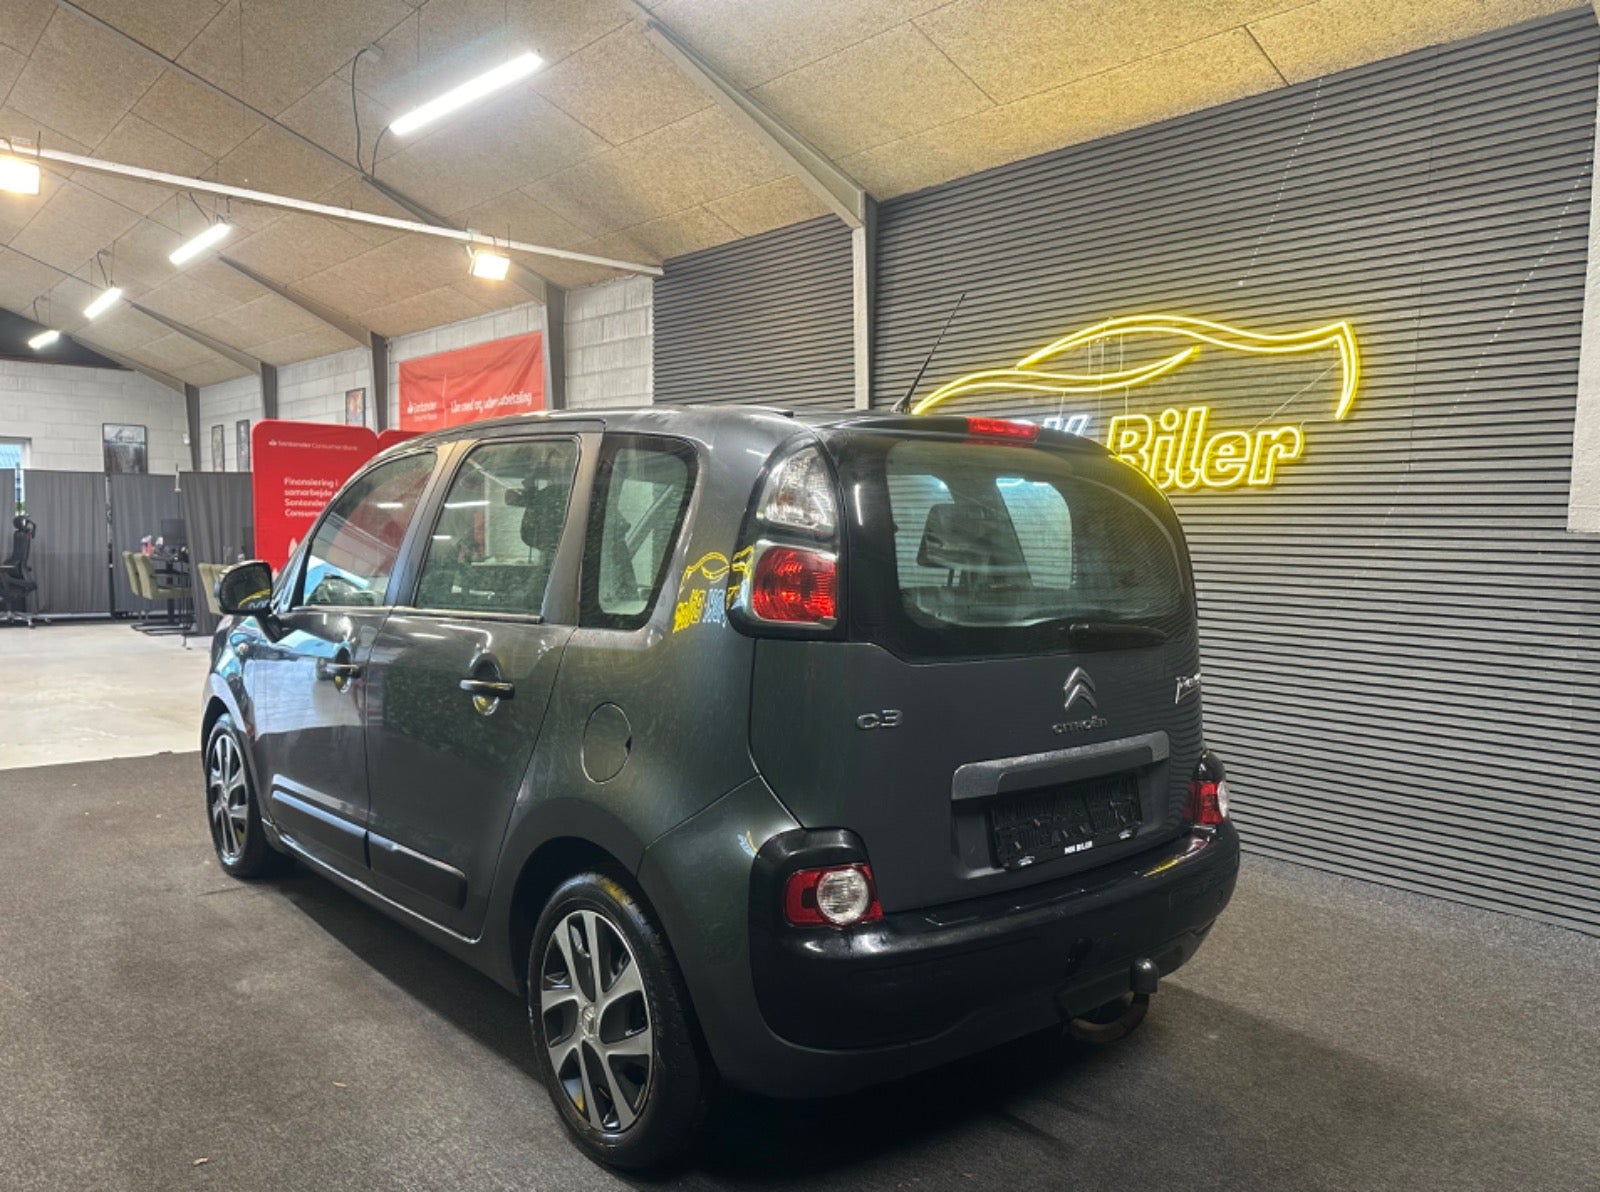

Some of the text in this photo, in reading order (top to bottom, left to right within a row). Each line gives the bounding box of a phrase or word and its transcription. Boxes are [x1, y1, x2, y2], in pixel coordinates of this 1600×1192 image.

[278, 440, 311, 448] Santander
[1107, 406, 1304, 489] Biler
[284, 477, 334, 488] Finansiering
[284, 488, 332, 499] samarbejde
[857, 709, 902, 729] C3
